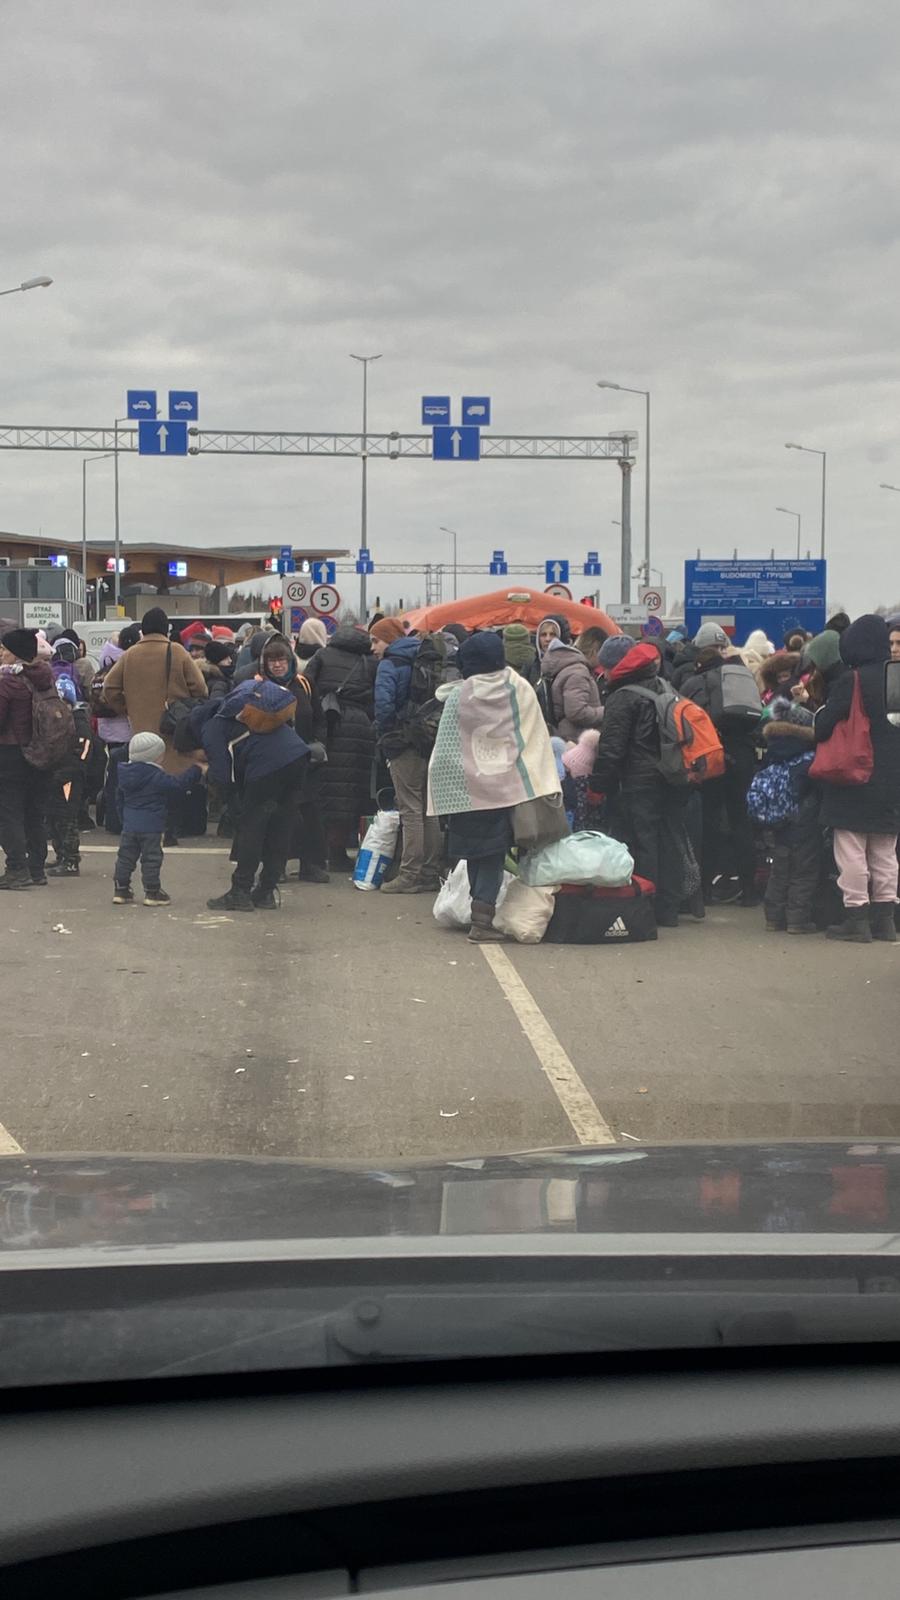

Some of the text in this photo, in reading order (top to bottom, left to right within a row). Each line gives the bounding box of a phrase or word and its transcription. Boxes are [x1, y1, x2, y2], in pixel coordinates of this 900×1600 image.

[291, 587, 304, 597] 20
[320, 592, 330, 607] 5
[646, 596, 659, 606] 20
